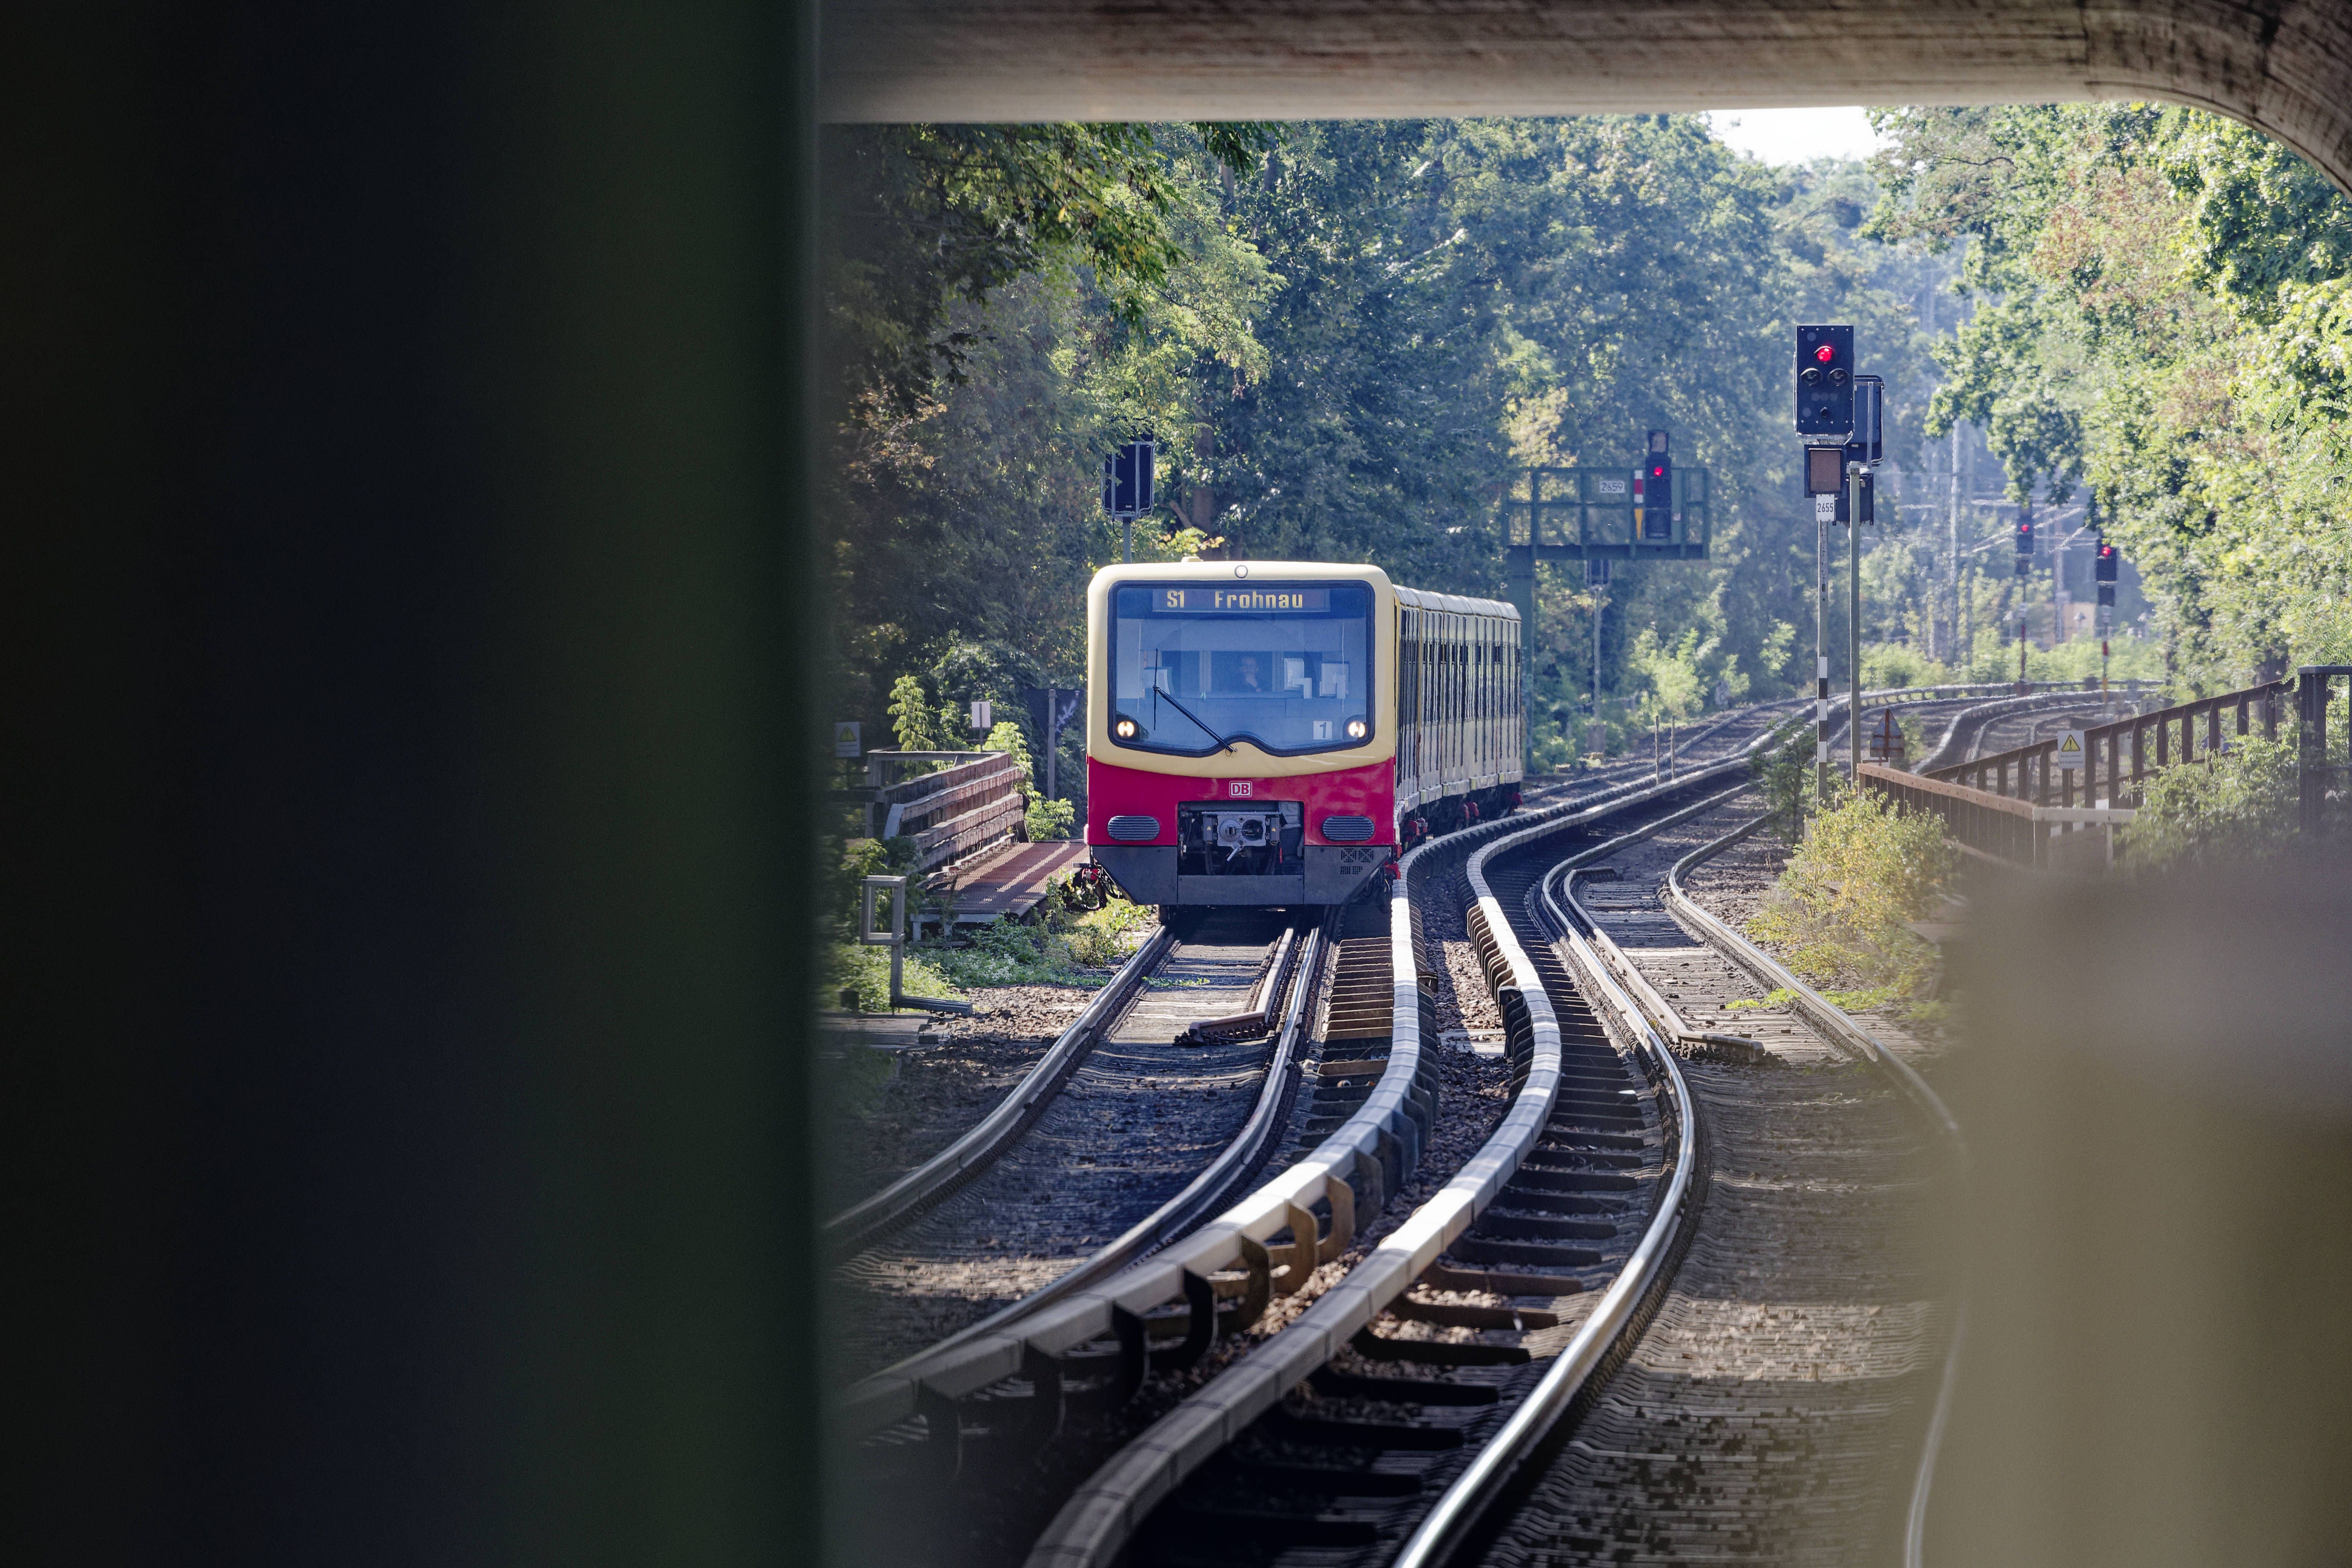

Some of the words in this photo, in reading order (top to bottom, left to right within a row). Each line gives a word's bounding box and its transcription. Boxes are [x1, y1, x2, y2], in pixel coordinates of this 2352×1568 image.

[1602, 483, 1623, 491] 2659
[1817, 503, 1833, 512] 2655
[1167, 590, 1184, 608] S1
[1215, 591, 1303, 608] Frohnau
[1319, 722, 1327, 739] 1
[1232, 784, 1249, 795] DB
